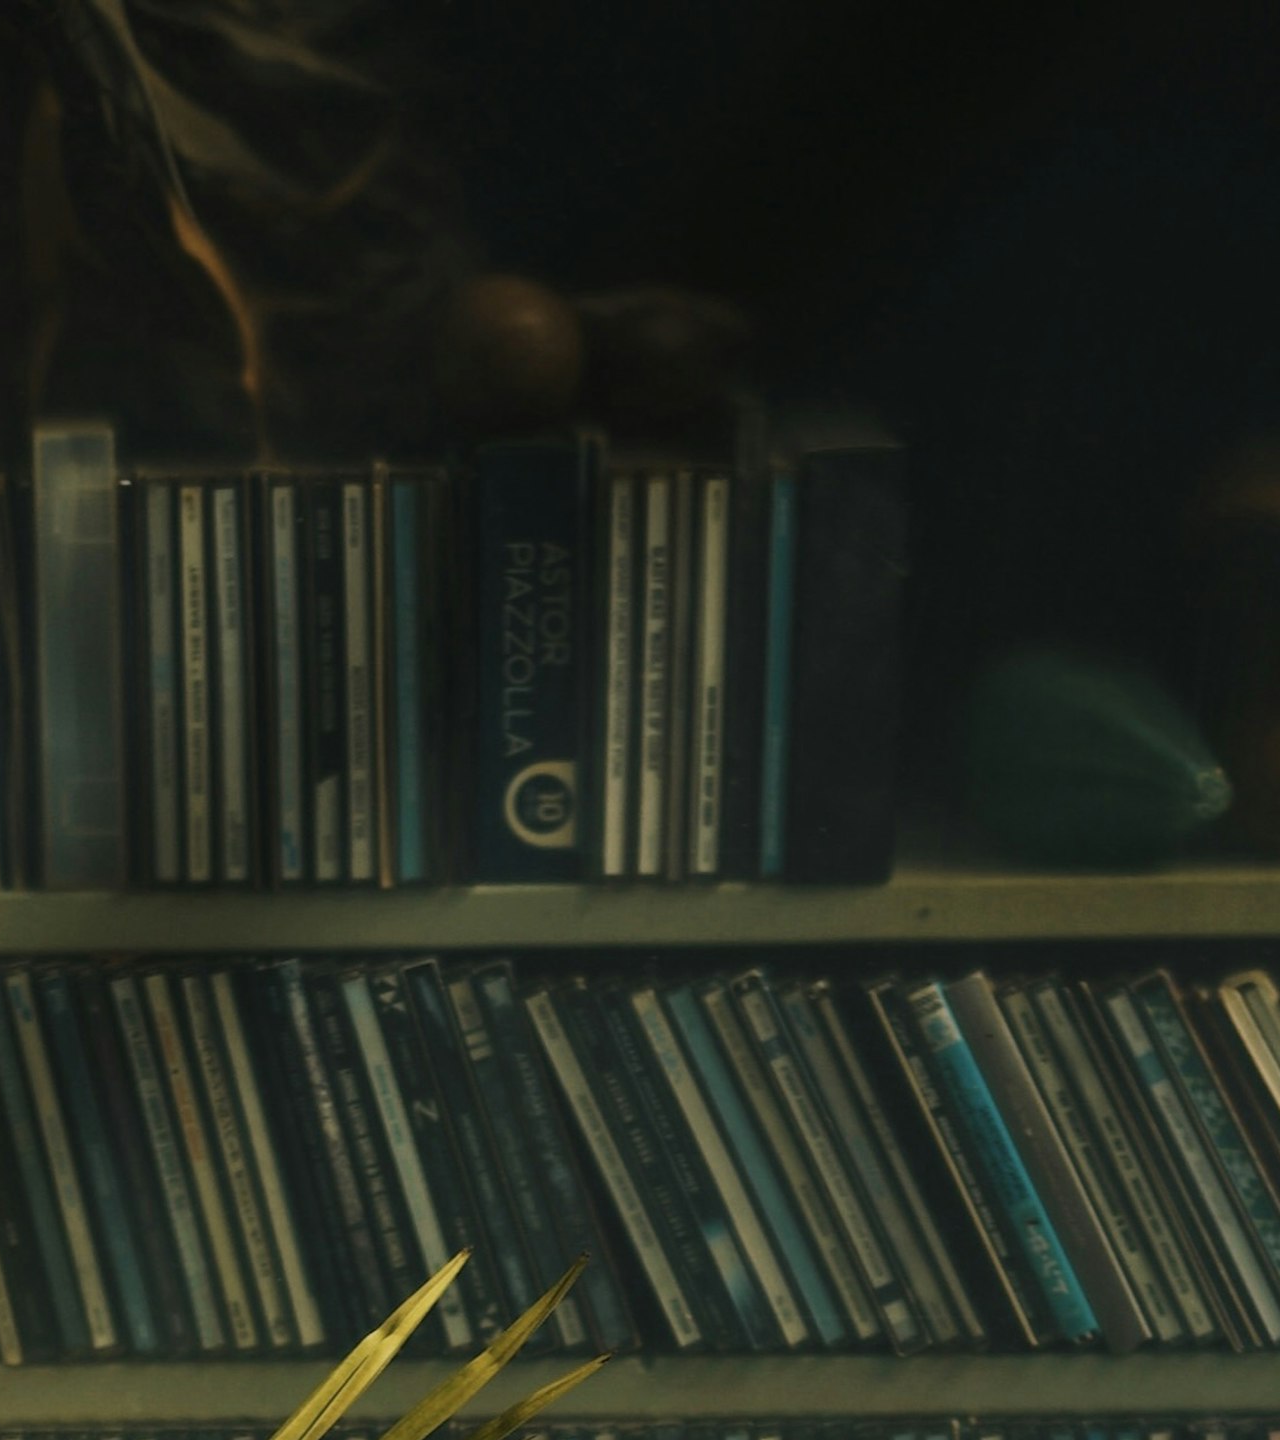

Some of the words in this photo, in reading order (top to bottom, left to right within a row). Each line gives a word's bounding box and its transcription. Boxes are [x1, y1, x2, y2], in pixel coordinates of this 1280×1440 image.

[503, 543, 536, 758] PIAZZOLLA
[540, 541, 570, 666] ASTOR
[537, 793, 565, 822] 10
